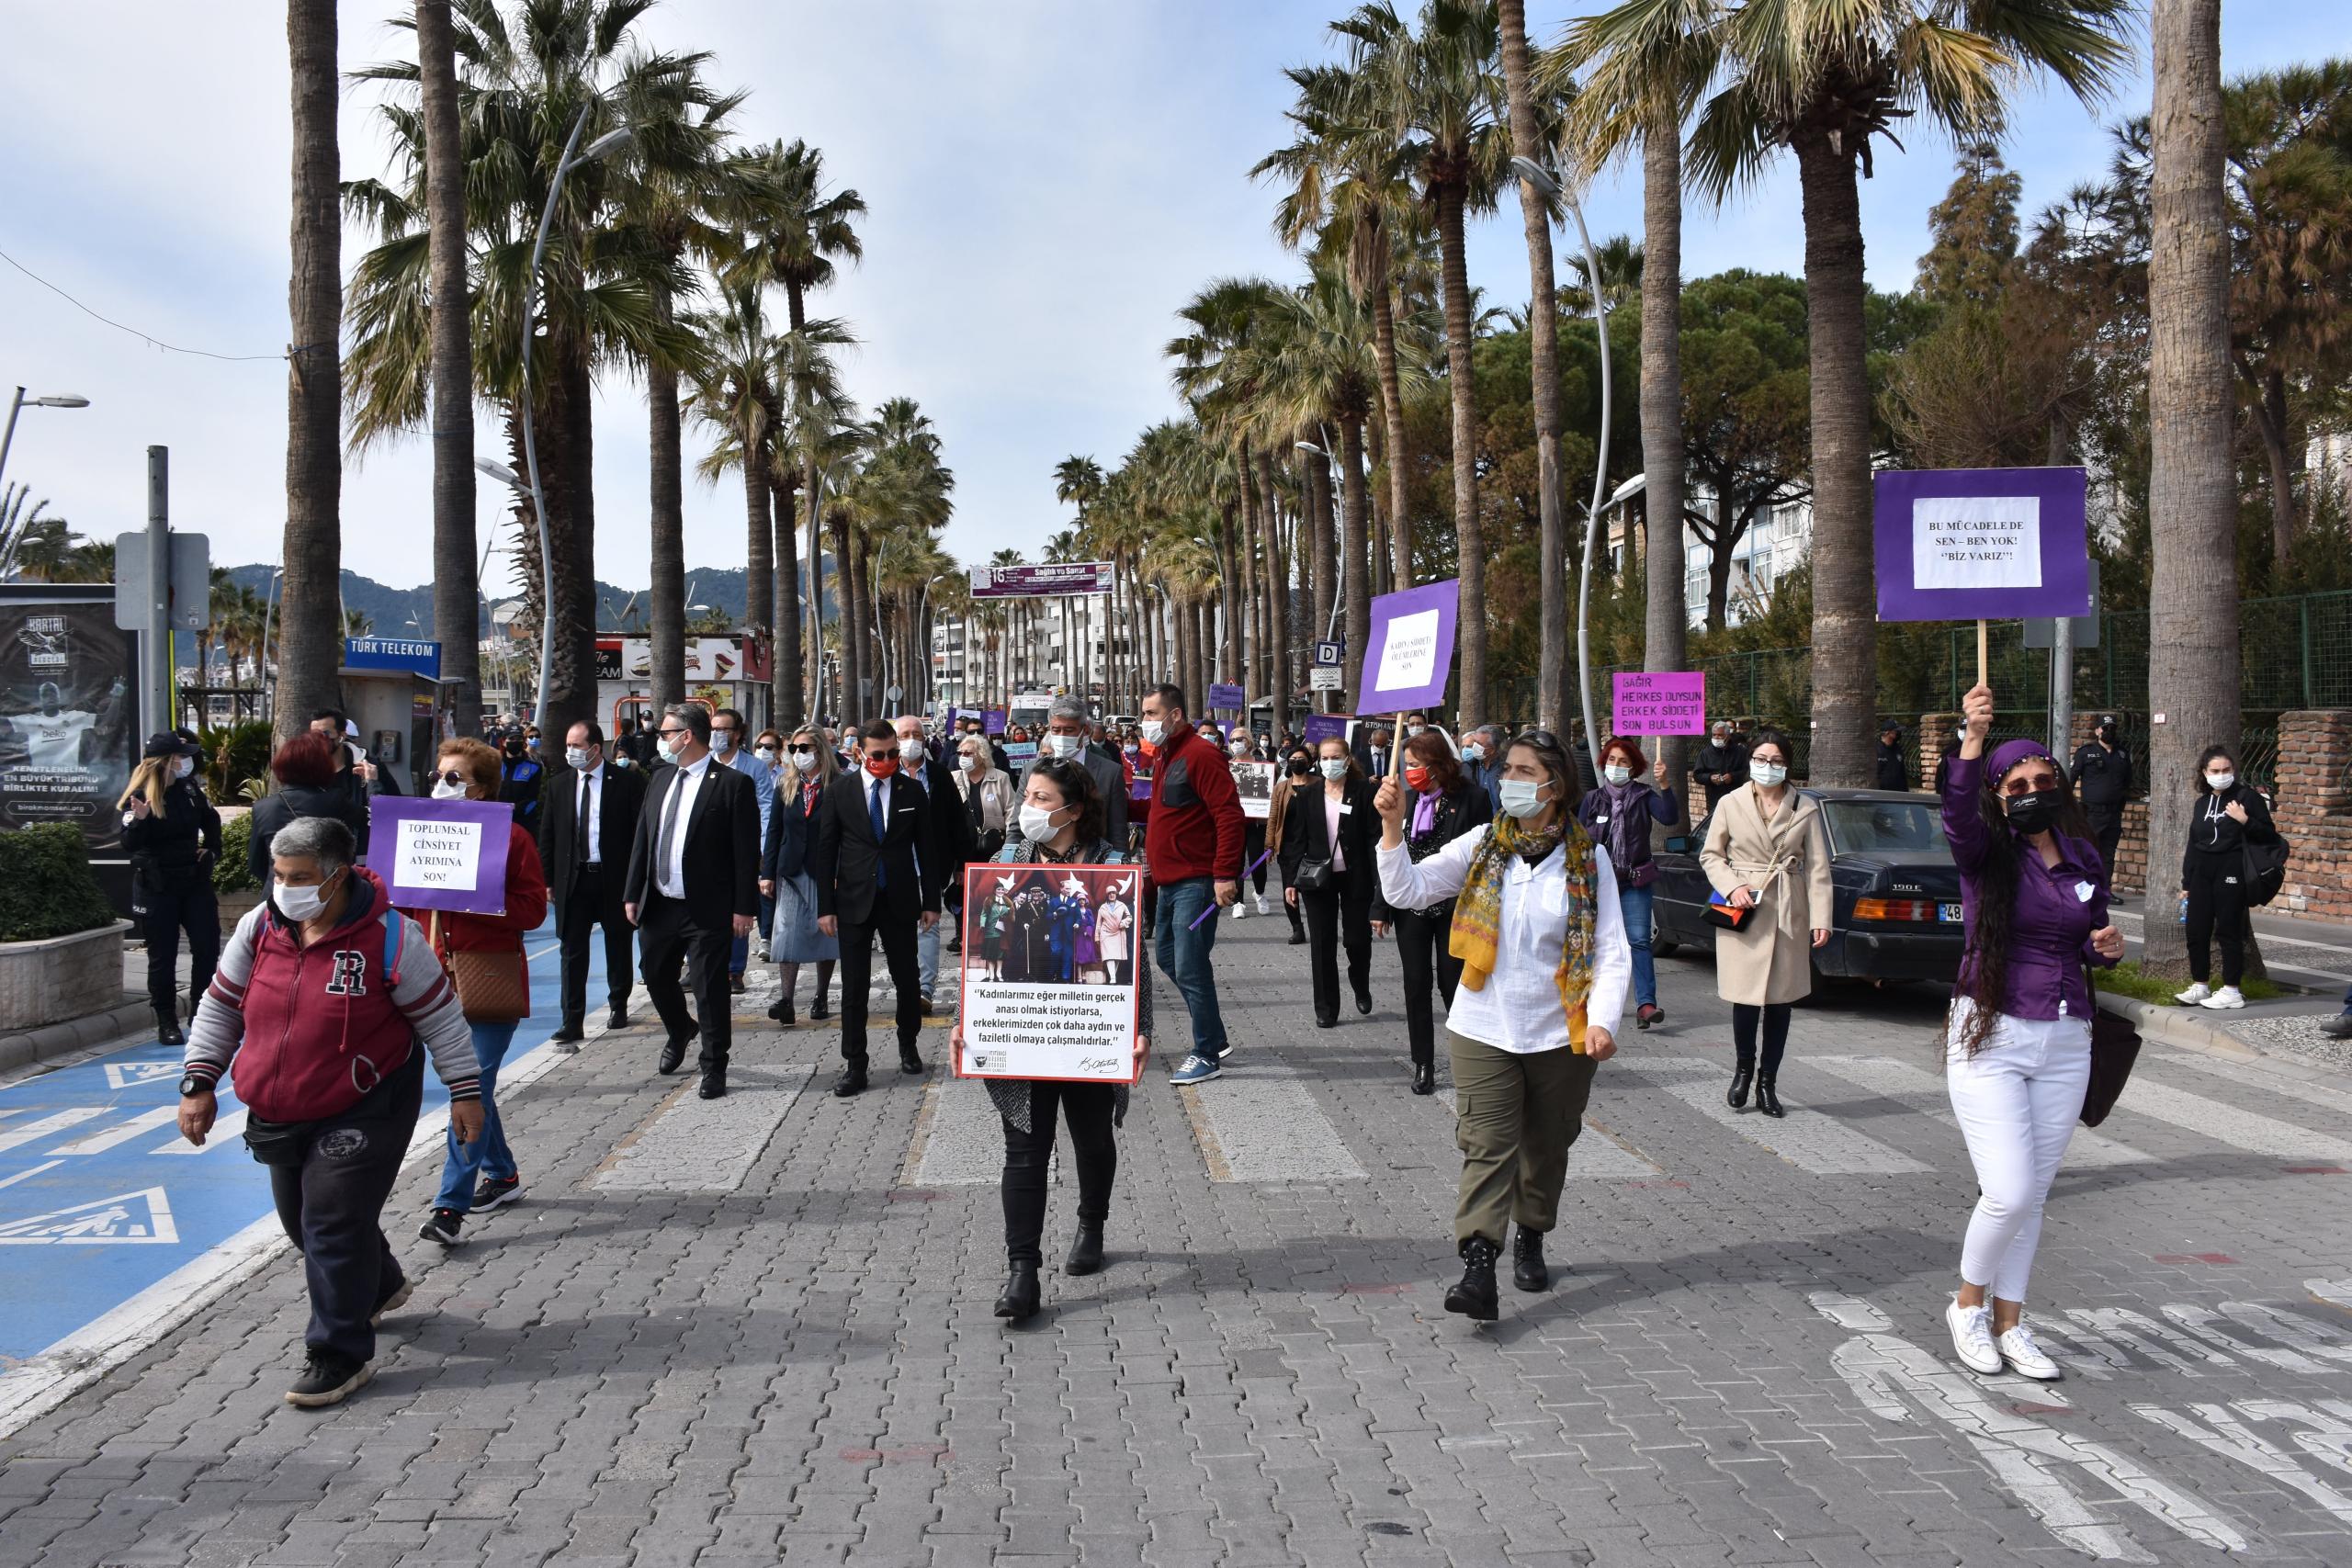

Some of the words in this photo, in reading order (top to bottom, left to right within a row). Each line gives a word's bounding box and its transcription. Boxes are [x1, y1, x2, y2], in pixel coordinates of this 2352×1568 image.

[1928, 522, 1943, 531] BU
[1946, 520, 2007, 531] MÜCADELE
[2009, 521, 2024, 530] DE
[1935, 537, 1956, 546] SEN
[1966, 536, 1987, 546] BEN
[1990, 536, 2018, 545] YOK!
[1066, 567, 1086, 575] Sanat
[351, 638, 378, 653] TÜRK
[381, 642, 433, 657] TELEKOM
[1324, 648, 1333, 660] D
[1622, 692, 1662, 702] HERKES
[1666, 691, 1702, 702] DUYSUN
[1621, 705, 1657, 716] ERKEK
[1623, 720, 1642, 730] SON
[1648, 719, 1691, 730] BULSUN
[42, 729, 67, 738] beko
[20, 774, 53, 783] BÜYÜK
[3, 784, 49, 792] BİRLİKTE
[408, 823, 470, 835] TOPLUMSAL
[413, 838, 462, 851] CİNSİYET
[410, 855, 463, 867] AYRIMINA
[423, 872, 447, 882] SON!
[1947, 906, 1962, 919] 48
[325, 950, 367, 997] R
[1036, 990, 1057, 1001] eğer
[1058, 990, 1093, 1001] milletin
[1095, 991, 1125, 1002] gerçek
[995, 1006, 1019, 1014] anası
[1021, 1005, 1047, 1015] olmak
[1049, 1006, 1102, 1018] istiyorlarsa,
[973, 1019, 1044, 1030] erkeklerimizden
[1046, 1020, 1061, 1031] çok
[1063, 1021, 1085, 1031] daha
[1087, 1021, 1113, 1032] aydın
[1114, 1023, 1125, 1032] ve
[978, 1032, 1012, 1043] faziletli
[1012, 1033, 1046, 1044] olmaya
